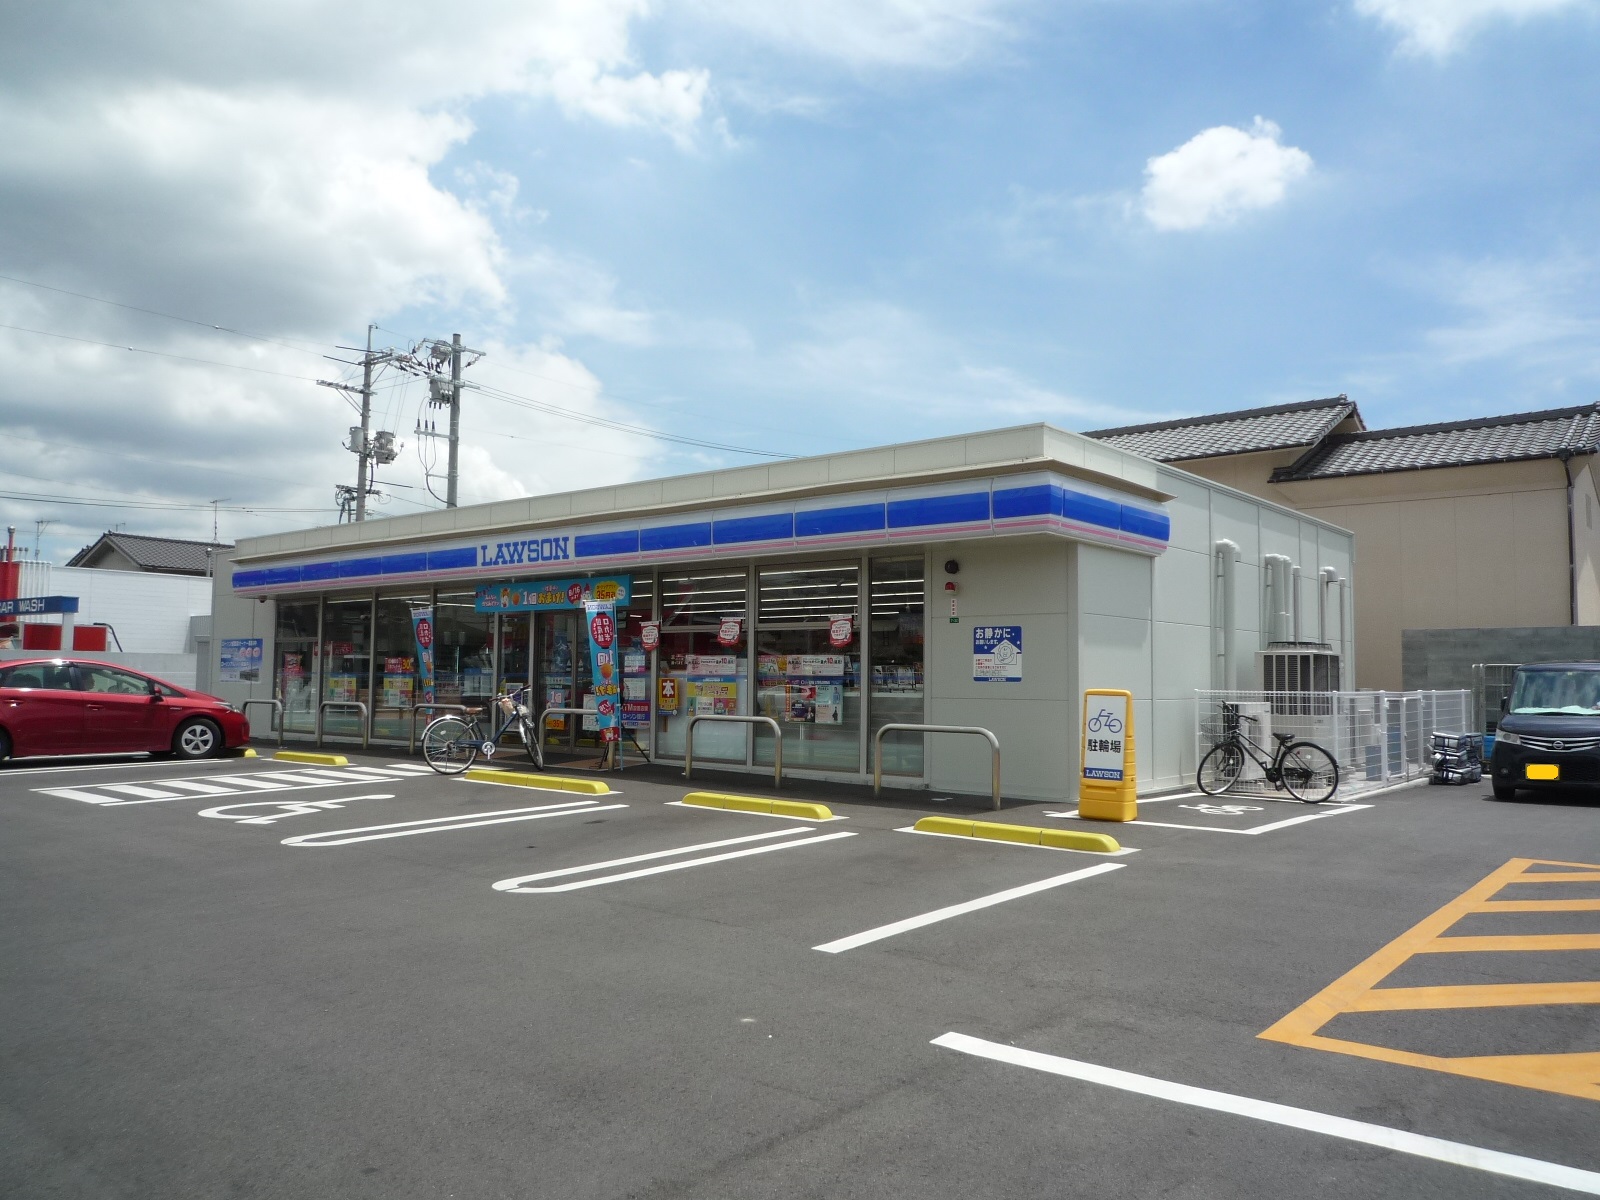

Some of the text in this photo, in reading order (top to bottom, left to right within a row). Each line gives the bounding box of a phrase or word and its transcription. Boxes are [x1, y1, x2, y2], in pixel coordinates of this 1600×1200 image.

[481, 537, 569, 566] LAWSON
[20, 599, 45, 611] WASH
[976, 628, 1011, 639] お静かに
[662, 680, 675, 697] 本
[1087, 739, 1121, 753] 駐輪場
[1085, 769, 1121, 779] LAWSON
